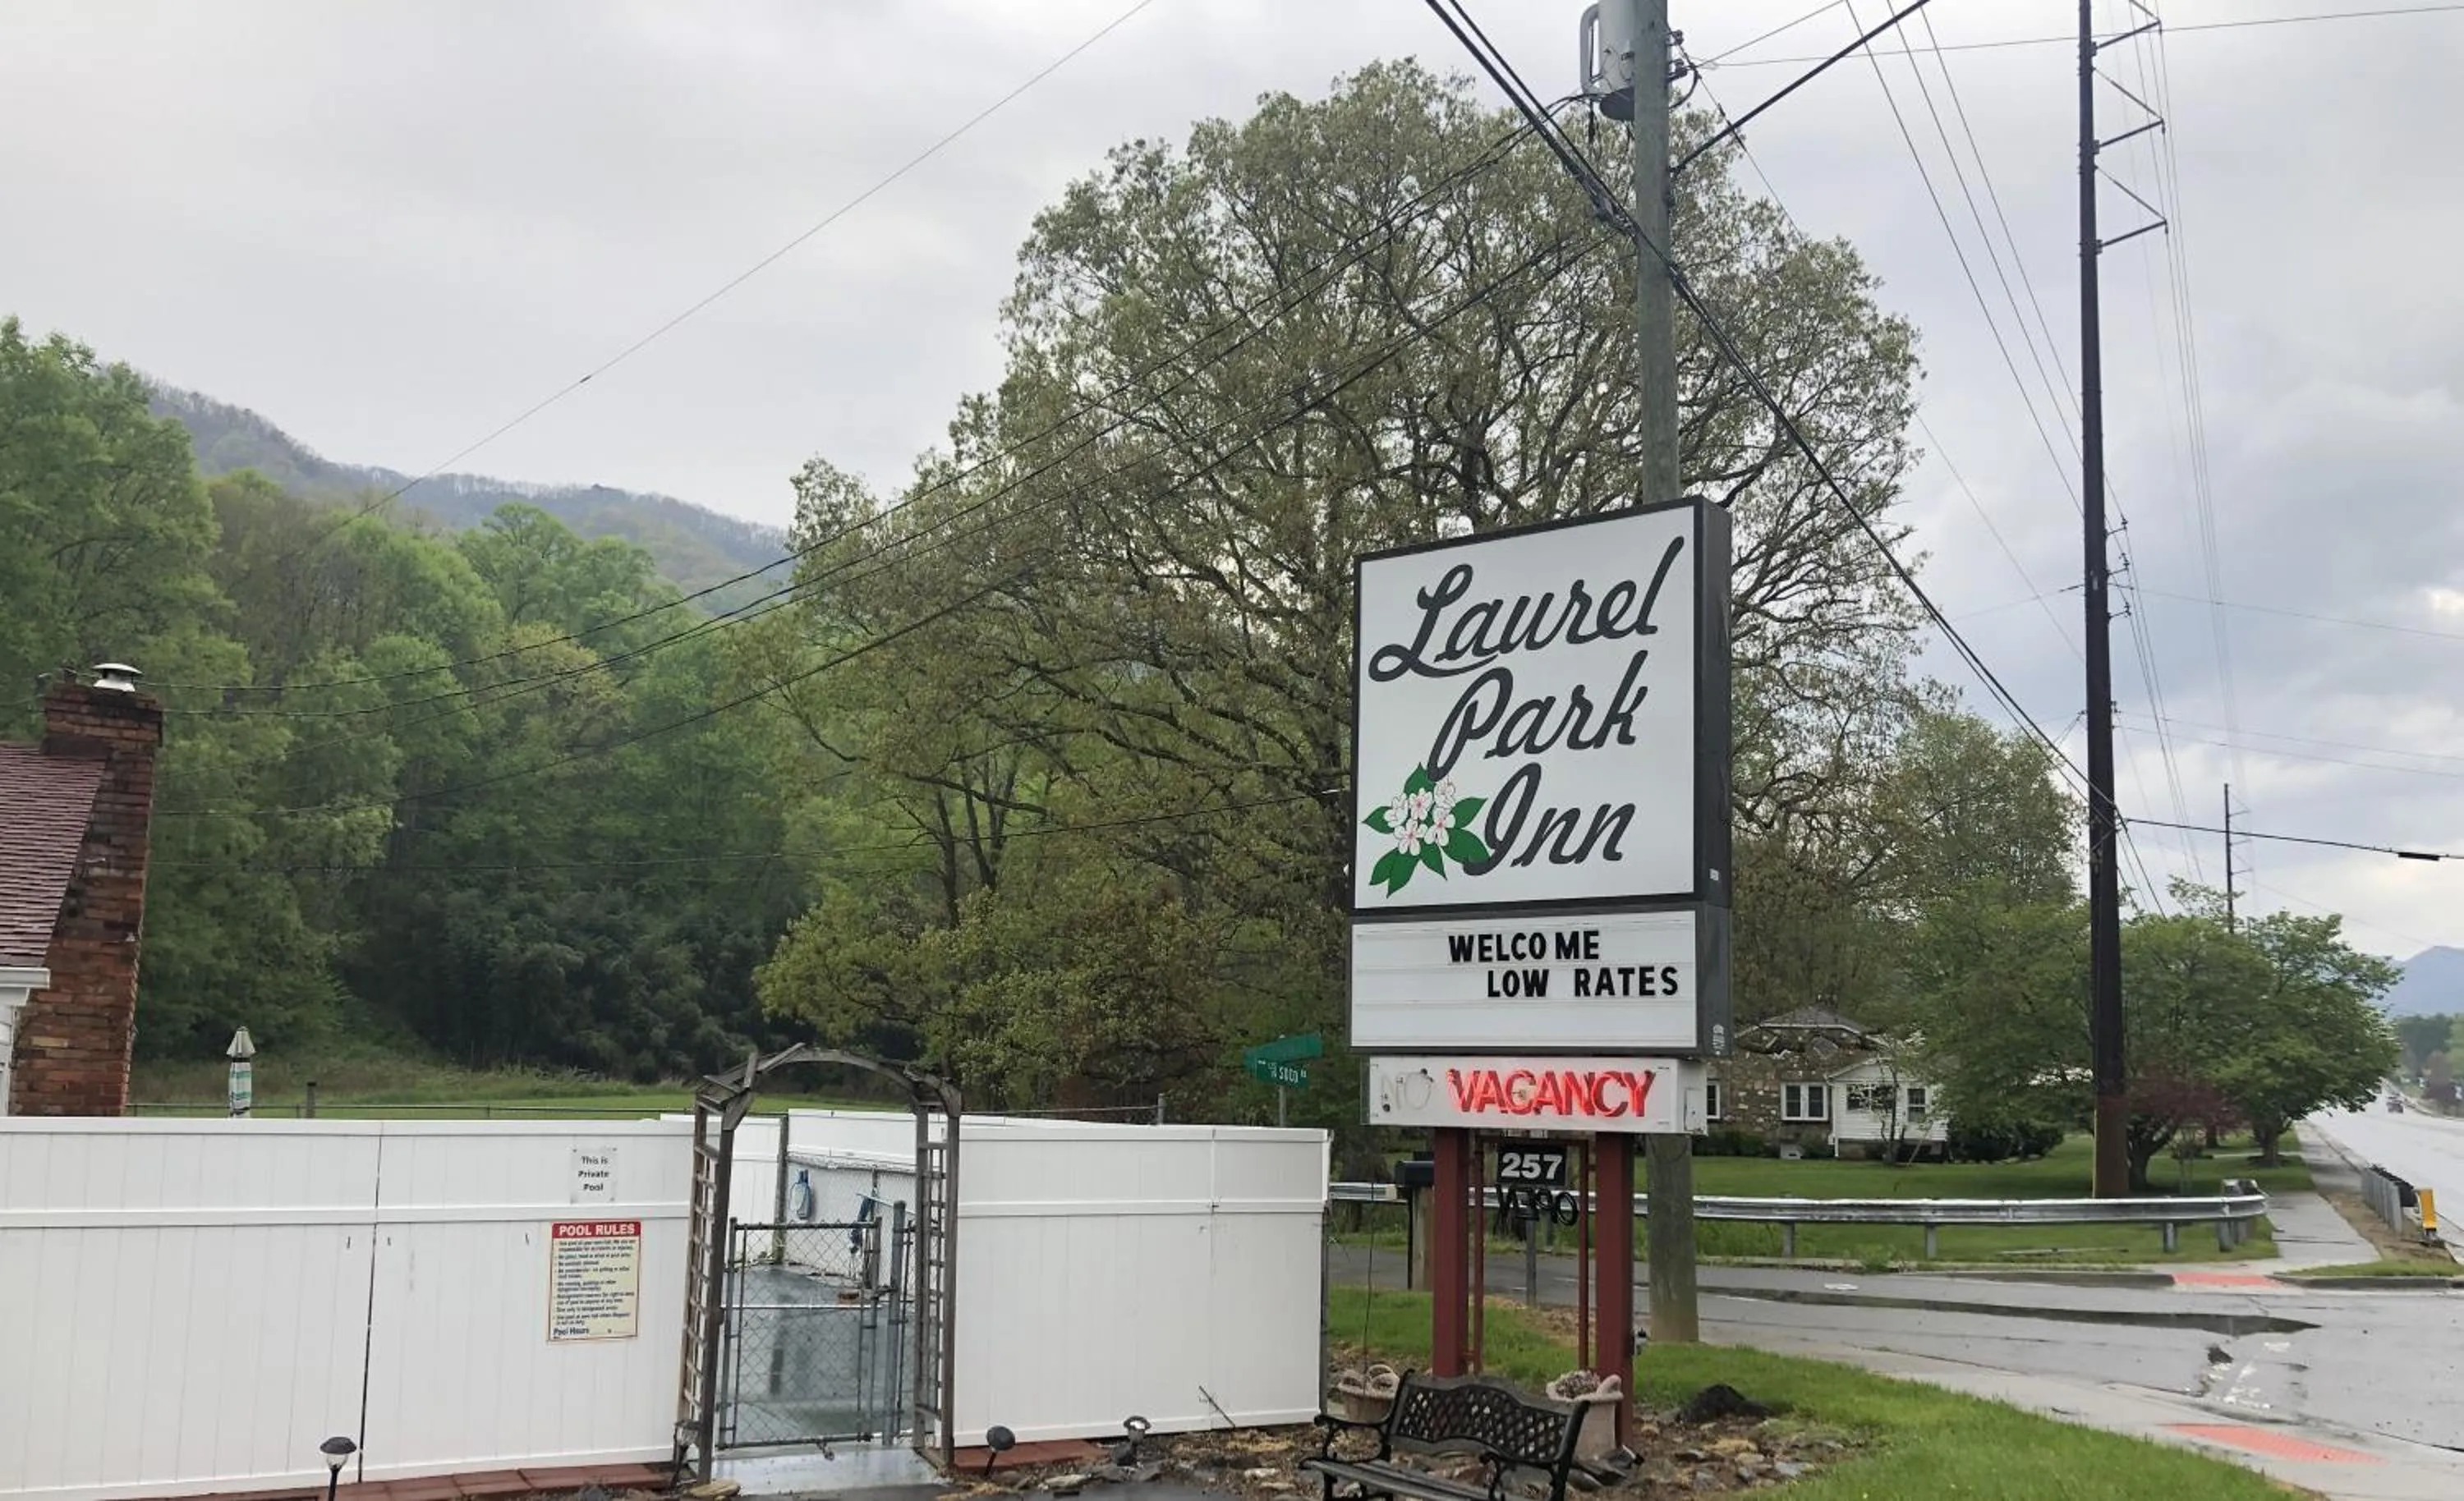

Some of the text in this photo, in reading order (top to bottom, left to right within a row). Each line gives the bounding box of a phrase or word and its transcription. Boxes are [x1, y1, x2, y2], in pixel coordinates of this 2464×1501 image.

[1368, 535, 1685, 682] Laurel
[1427, 650, 1649, 782] Park
[1462, 763, 1636, 876] Inn
[1448, 930, 1600, 963] WELCOME
[1487, 966, 1679, 998] LOW RATES
[1381, 1068, 1657, 1118] NO VACANCY
[577, 1169, 609, 1178] Private
[580, 1155, 609, 1164] This is
[1501, 1152, 1563, 1180] 257
[583, 1182, 604, 1191] Pool
[559, 1223, 635, 1236] POOL RULES
